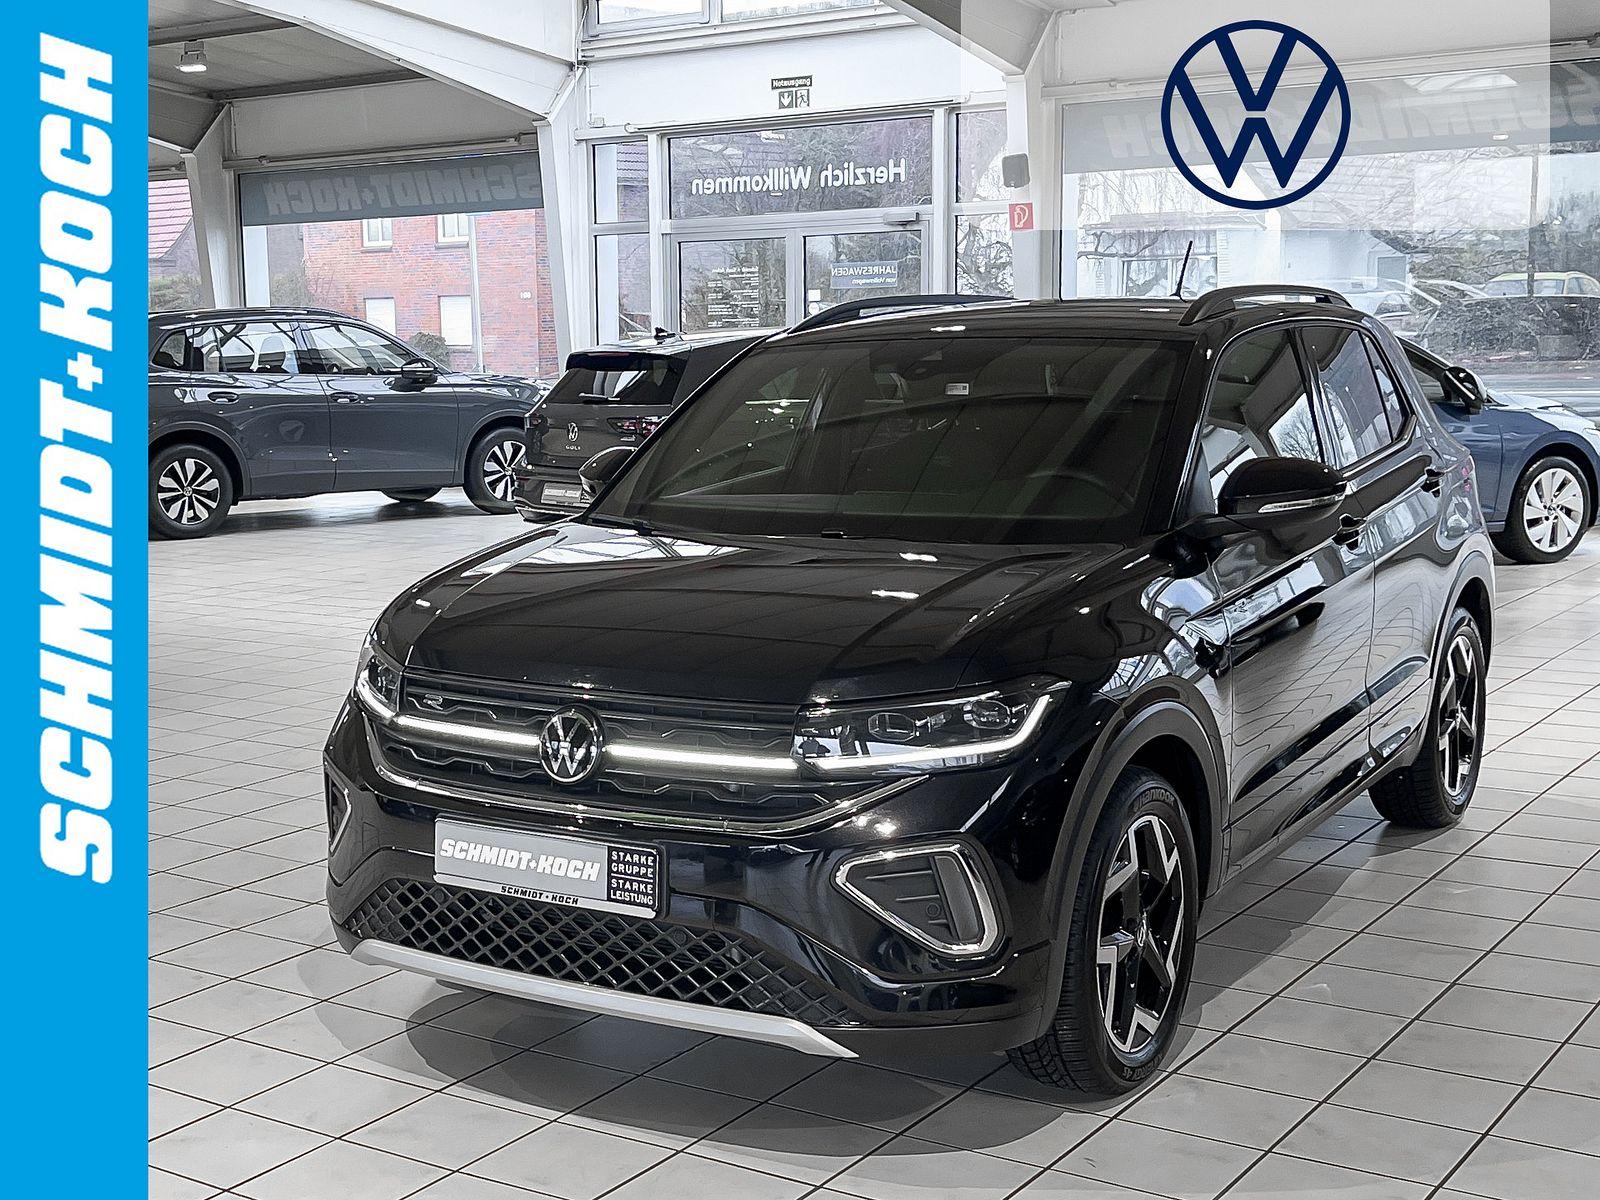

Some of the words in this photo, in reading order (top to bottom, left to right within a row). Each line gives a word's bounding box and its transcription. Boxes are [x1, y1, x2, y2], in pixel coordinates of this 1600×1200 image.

[440, 837, 601, 882] SCHMIDT+KOCH
[611, 850, 654, 866] STARKE
[611, 861, 654, 878] GRUPPE
[611, 878, 654, 894] STARKE
[500, 885, 544, 900] SCHMIDT
[551, 893, 579, 905] KOCH
[610, 890, 654, 906] LEISTUNG
